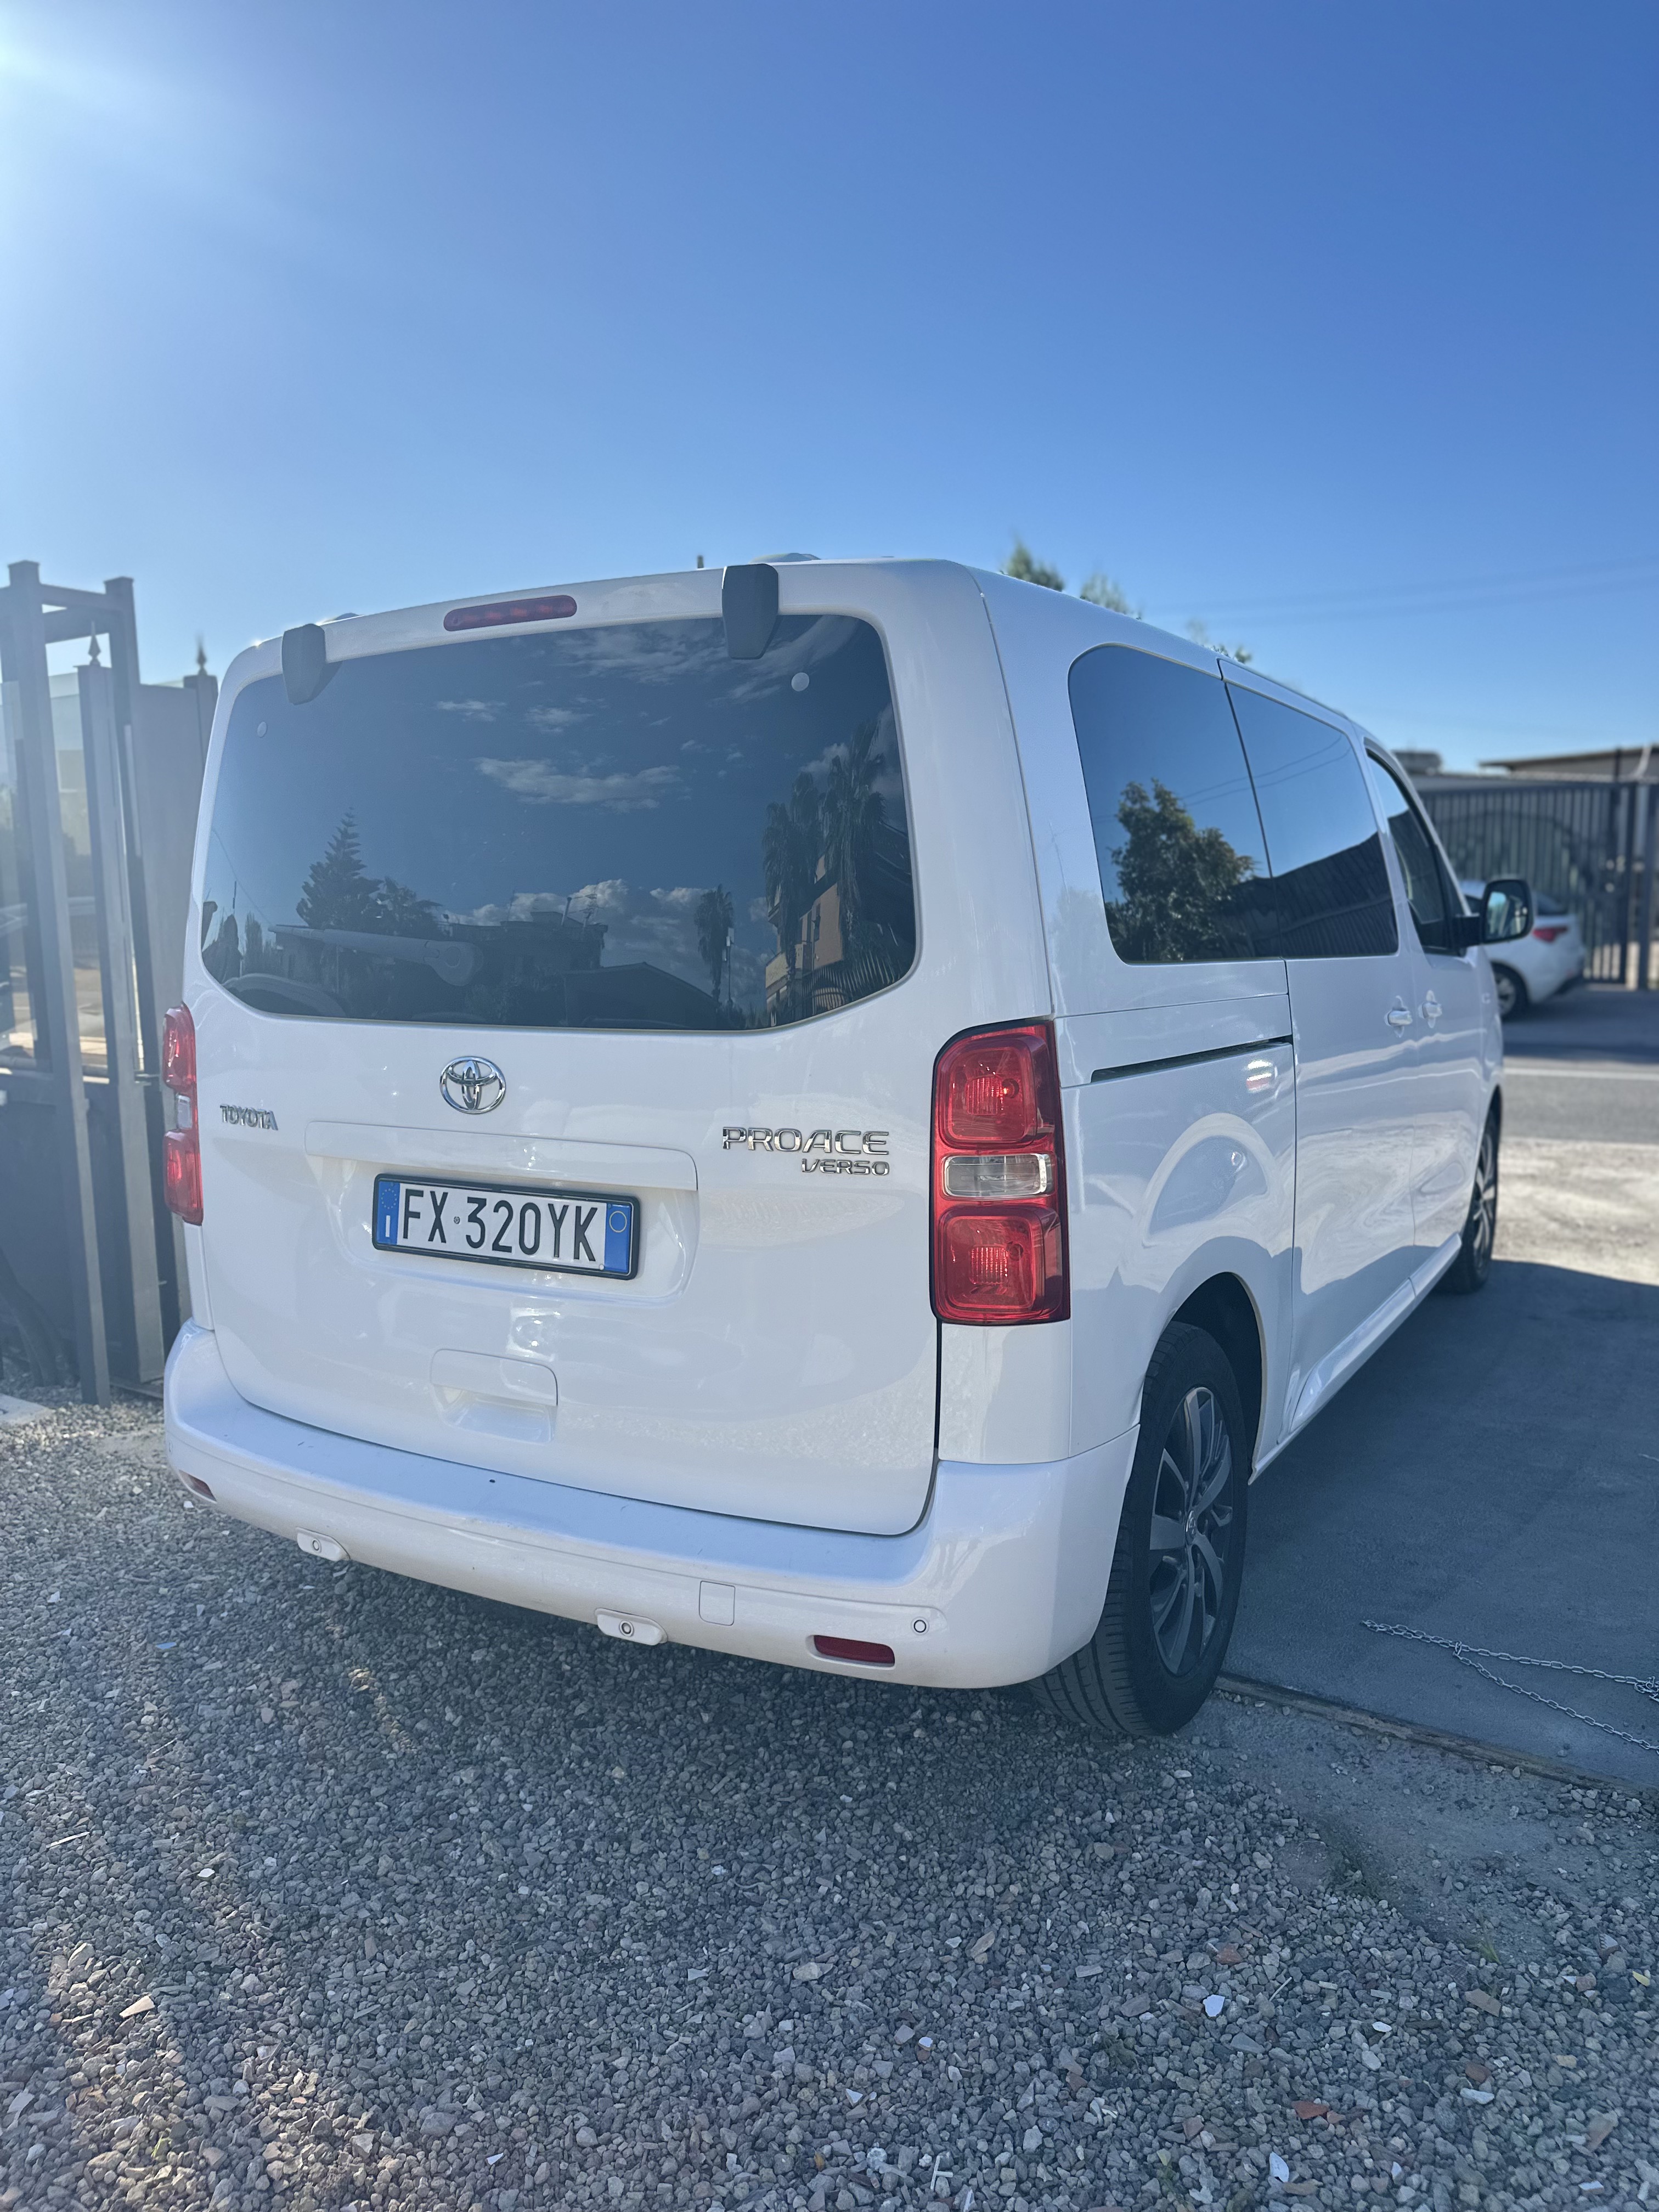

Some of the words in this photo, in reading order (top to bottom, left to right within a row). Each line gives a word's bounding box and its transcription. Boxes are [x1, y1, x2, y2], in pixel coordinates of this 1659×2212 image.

[220, 1104, 278, 1131] TOYOTA
[723, 1126, 889, 1155] PROACE
[802, 1158, 890, 1176] VERSO
